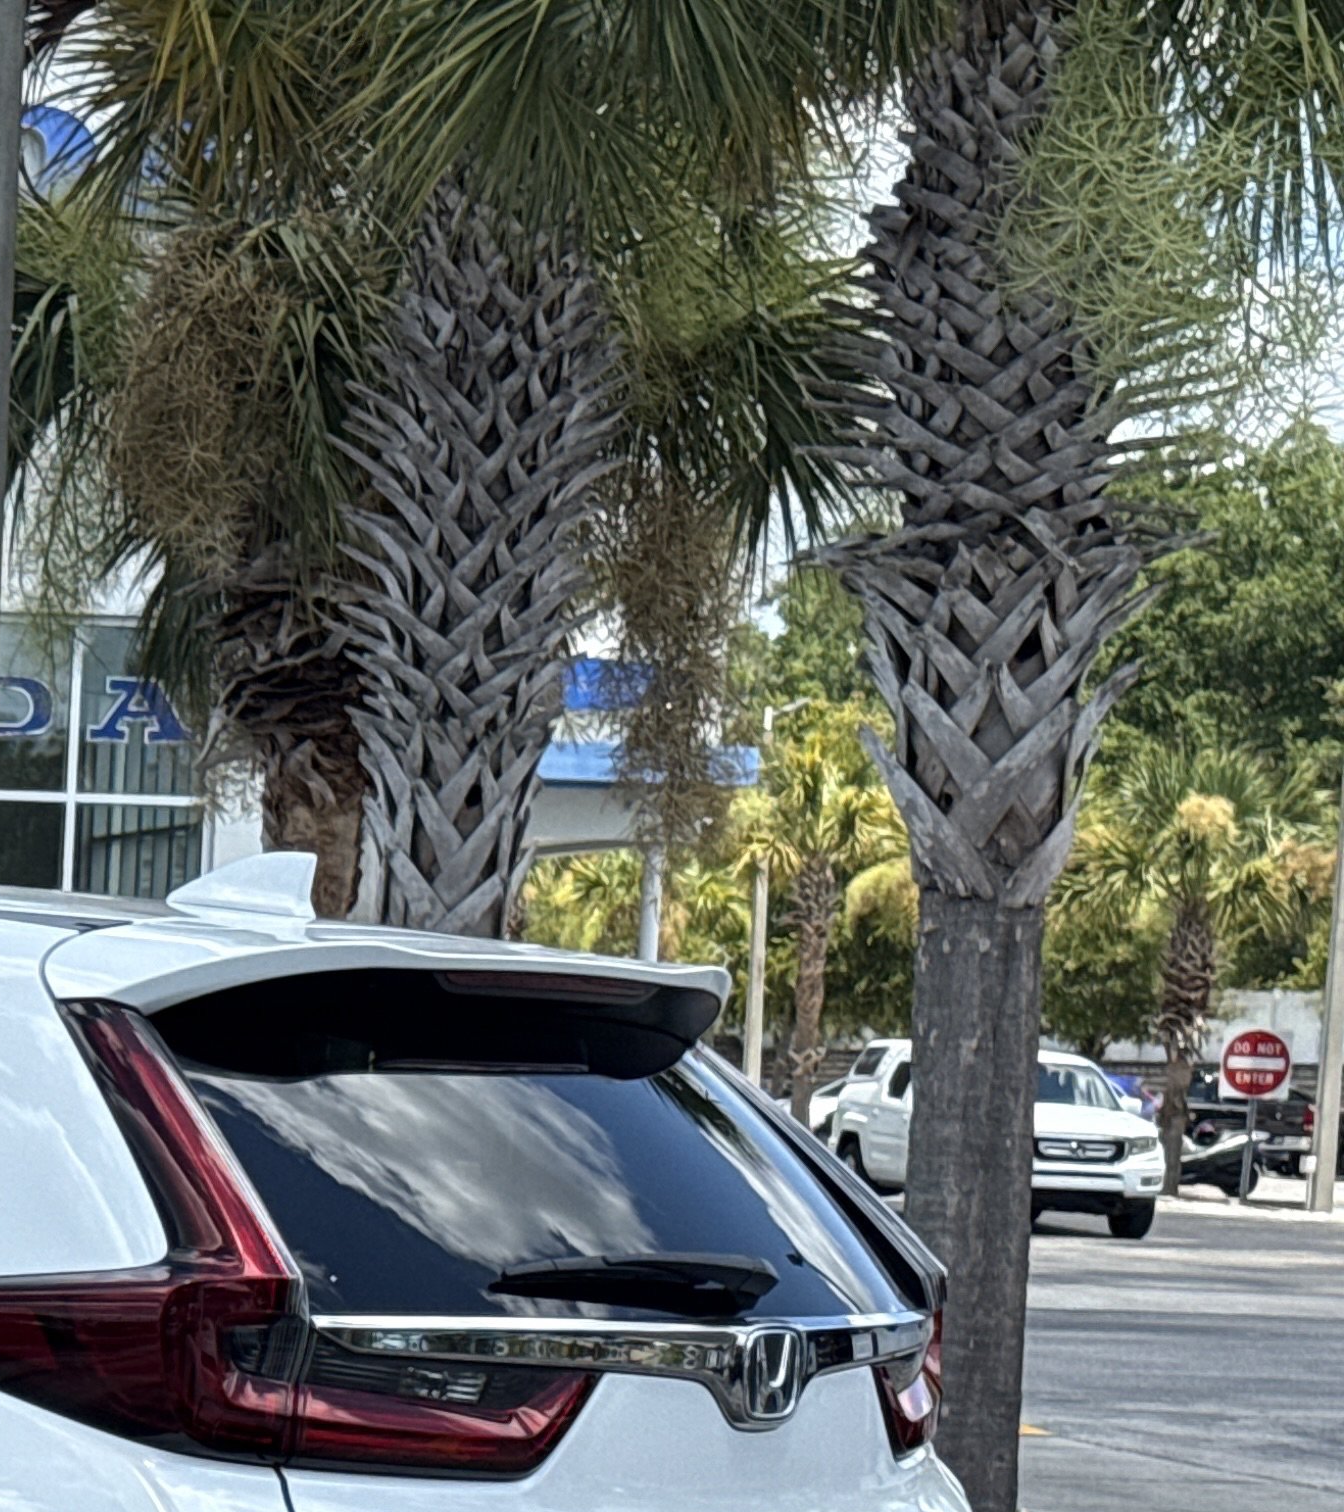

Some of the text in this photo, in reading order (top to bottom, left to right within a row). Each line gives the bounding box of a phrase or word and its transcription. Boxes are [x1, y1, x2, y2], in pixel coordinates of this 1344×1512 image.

[1234, 1041, 1282, 1055] DO NOT
[1235, 1071, 1274, 1085] ENTER
